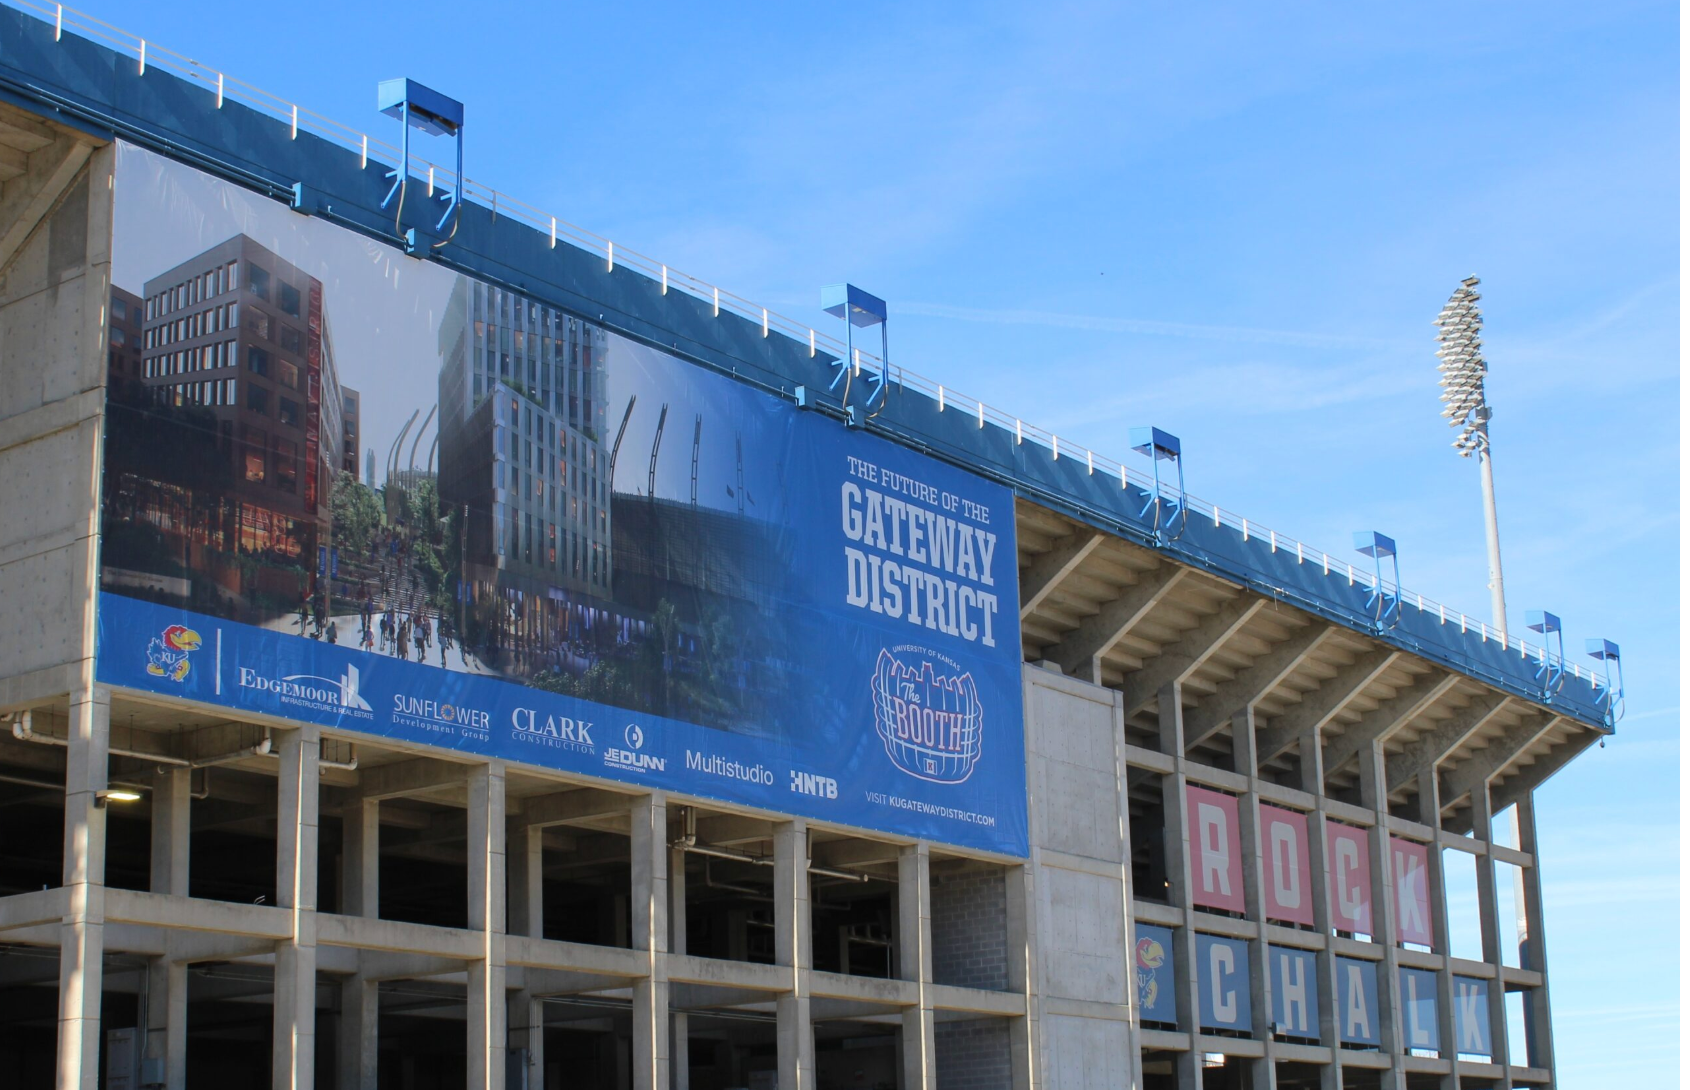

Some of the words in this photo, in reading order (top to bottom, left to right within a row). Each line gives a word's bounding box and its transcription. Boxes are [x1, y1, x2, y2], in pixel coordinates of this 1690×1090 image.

[847, 456, 877, 483] THE
[881, 468, 938, 506] FUTURE
[941, 491, 959, 512] OF
[962, 499, 990, 525] THE
[841, 481, 996, 586] GATEWAY
[845, 546, 997, 648] DISTRICT
[162, 652, 175, 664] KU
[892, 644, 927, 655] UNIVERSITY
[937, 653, 960, 672] KANSAS
[239, 667, 338, 706] EDGEMOOR
[901, 681, 921, 704] The
[280, 696, 332, 712] INFRASTRUCTURE
[339, 707, 353, 717] REAL
[354, 710, 374, 720] ESTATE
[393, 694, 489, 729] SUNFLOWER
[892, 696, 964, 751] BOOTH
[393, 714, 455, 735] Development
[461, 728, 490, 742] Group
[512, 707, 594, 745] CLARK
[512, 731, 595, 755] CONSTRUCTION
[604, 761, 646, 773] CONSTRUCTION
[686, 749, 774, 786] Multistudio
[791, 770, 838, 799] HNTB
[865, 791, 886, 805] VISIT
[889, 795, 995, 827] KUGATEWAYDISTRICT.COM
